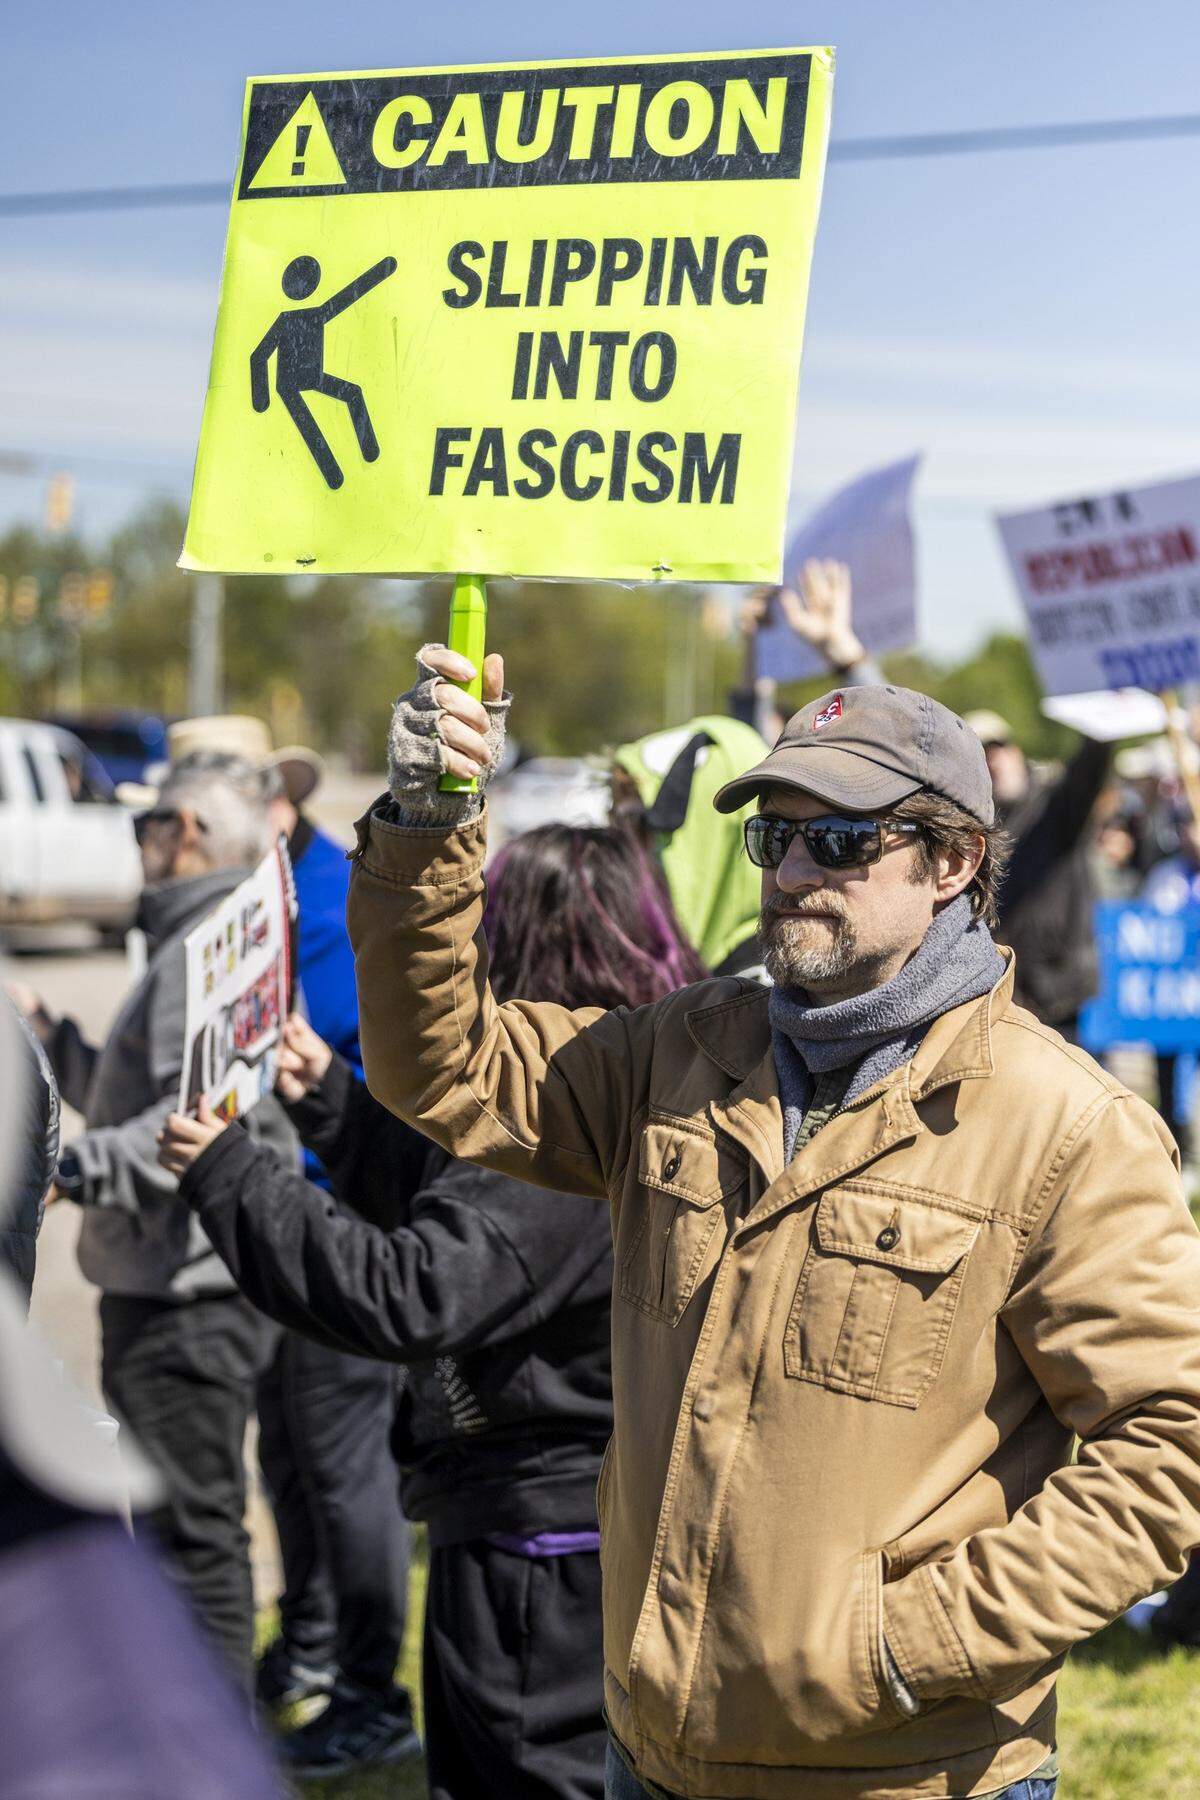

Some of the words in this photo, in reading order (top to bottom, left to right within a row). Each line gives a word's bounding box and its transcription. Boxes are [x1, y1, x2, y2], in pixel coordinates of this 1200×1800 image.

[372, 77, 788, 169] CAUTION
[443, 235, 768, 309] SLIPPING
[512, 331, 677, 403] INTO
[429, 427, 742, 504] FASCISM
